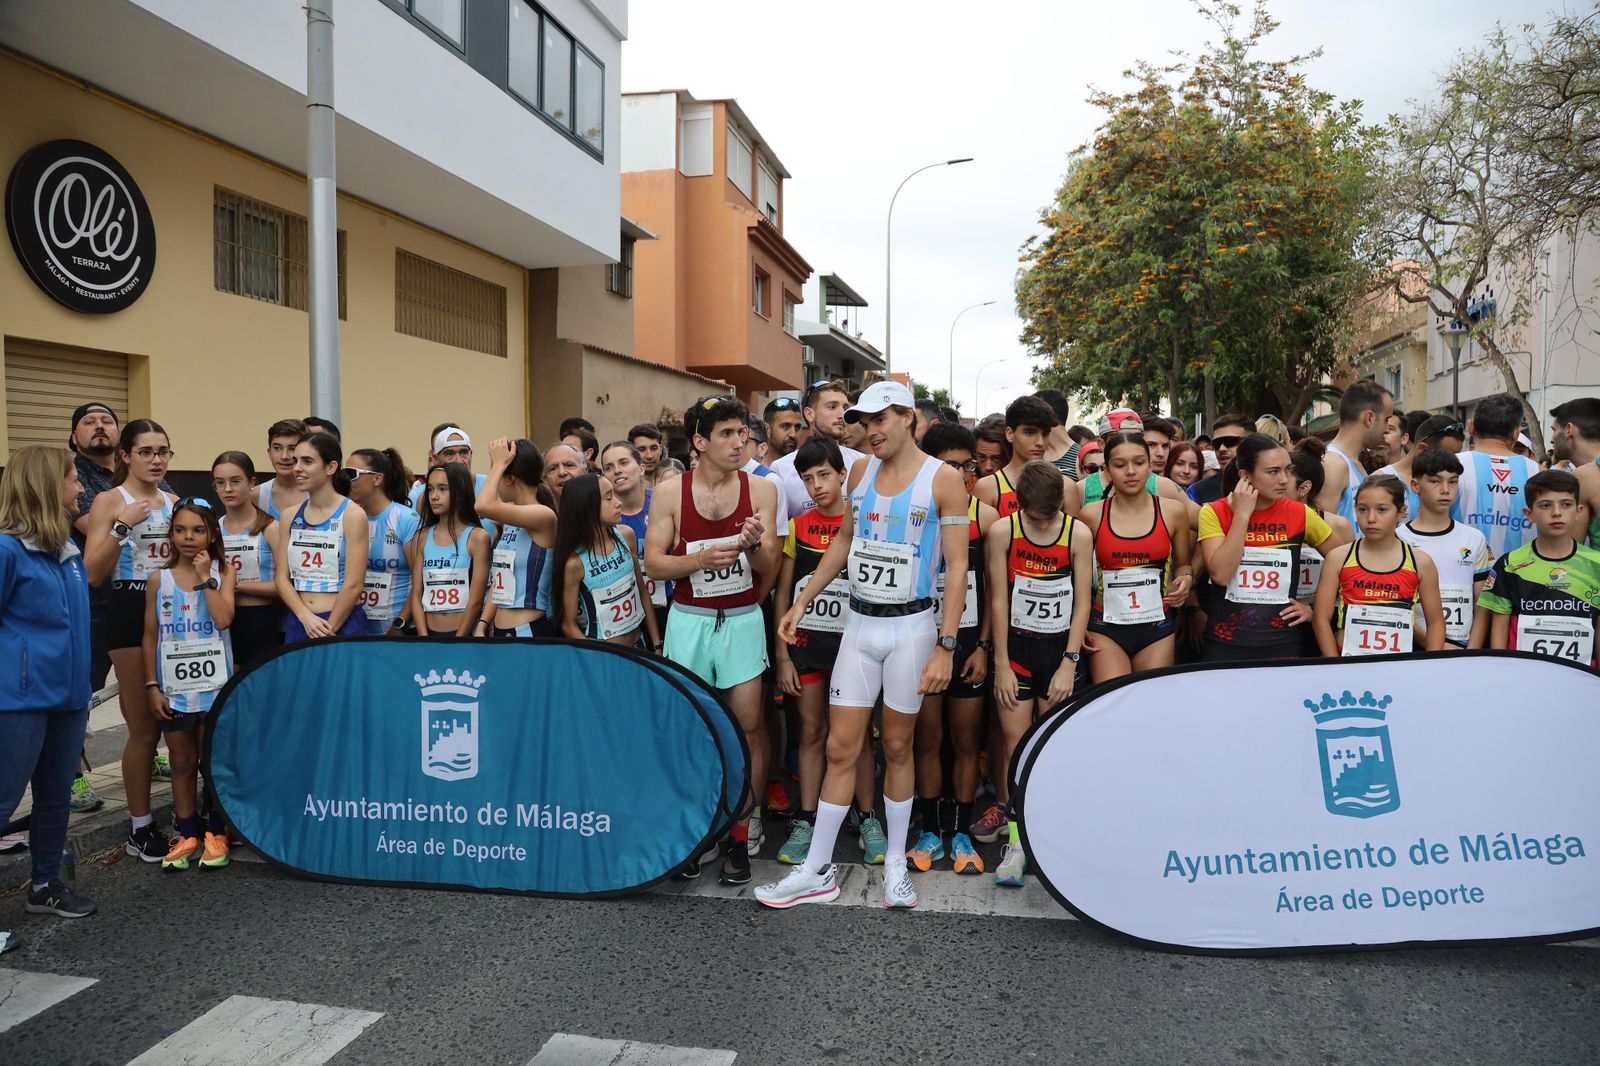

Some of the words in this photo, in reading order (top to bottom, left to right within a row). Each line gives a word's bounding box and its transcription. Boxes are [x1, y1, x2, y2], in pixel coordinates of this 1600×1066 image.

[49, 173, 126, 261] Olé
[72, 256, 111, 271] TERRAZA
[44, 259, 70, 288] MÁLAGA
[75, 287, 116, 300] RESTAURANT
[120, 276, 140, 295] EVENTS
[1487, 483, 1519, 495] vive
[1245, 531, 1288, 542] Bahía
[301, 551, 323, 568] 24
[1016, 548, 1059, 566] Málaga
[1112, 551, 1151, 560] Málaga
[590, 557, 625, 578] nerja
[704, 558, 744, 583] 504
[858, 563, 897, 588] 571
[1025, 560, 1058, 572] Bahía
[1239, 570, 1281, 590] 198
[1353, 580, 1400, 592] Málaga
[430, 588, 460, 606] 298
[1128, 591, 1140, 609] 1
[1364, 589, 1399, 599] Bahía
[611, 593, 637, 622] 291
[806, 599, 841, 618] 900
[1025, 600, 1062, 619] 751
[1520, 598, 1590, 612] tecnoaire
[1359, 629, 1400, 652] 151
[1533, 640, 1580, 660] 674
[175, 660, 216, 681] 680
[303, 794, 468, 823] Ayuntamiento
[477, 802, 508, 826] de
[516, 804, 611, 837] Málaga
[376, 831, 417, 854] Área
[423, 838, 445, 855] de
[453, 839, 527, 862] Deporte
[1163, 842, 1396, 883] Ayuntamiento
[1409, 838, 1449, 866] de
[1459, 832, 1586, 866] Málaga
[1276, 886, 1334, 913] Área
[1342, 889, 1373, 911] de
[1382, 884, 1485, 911] Deporte
